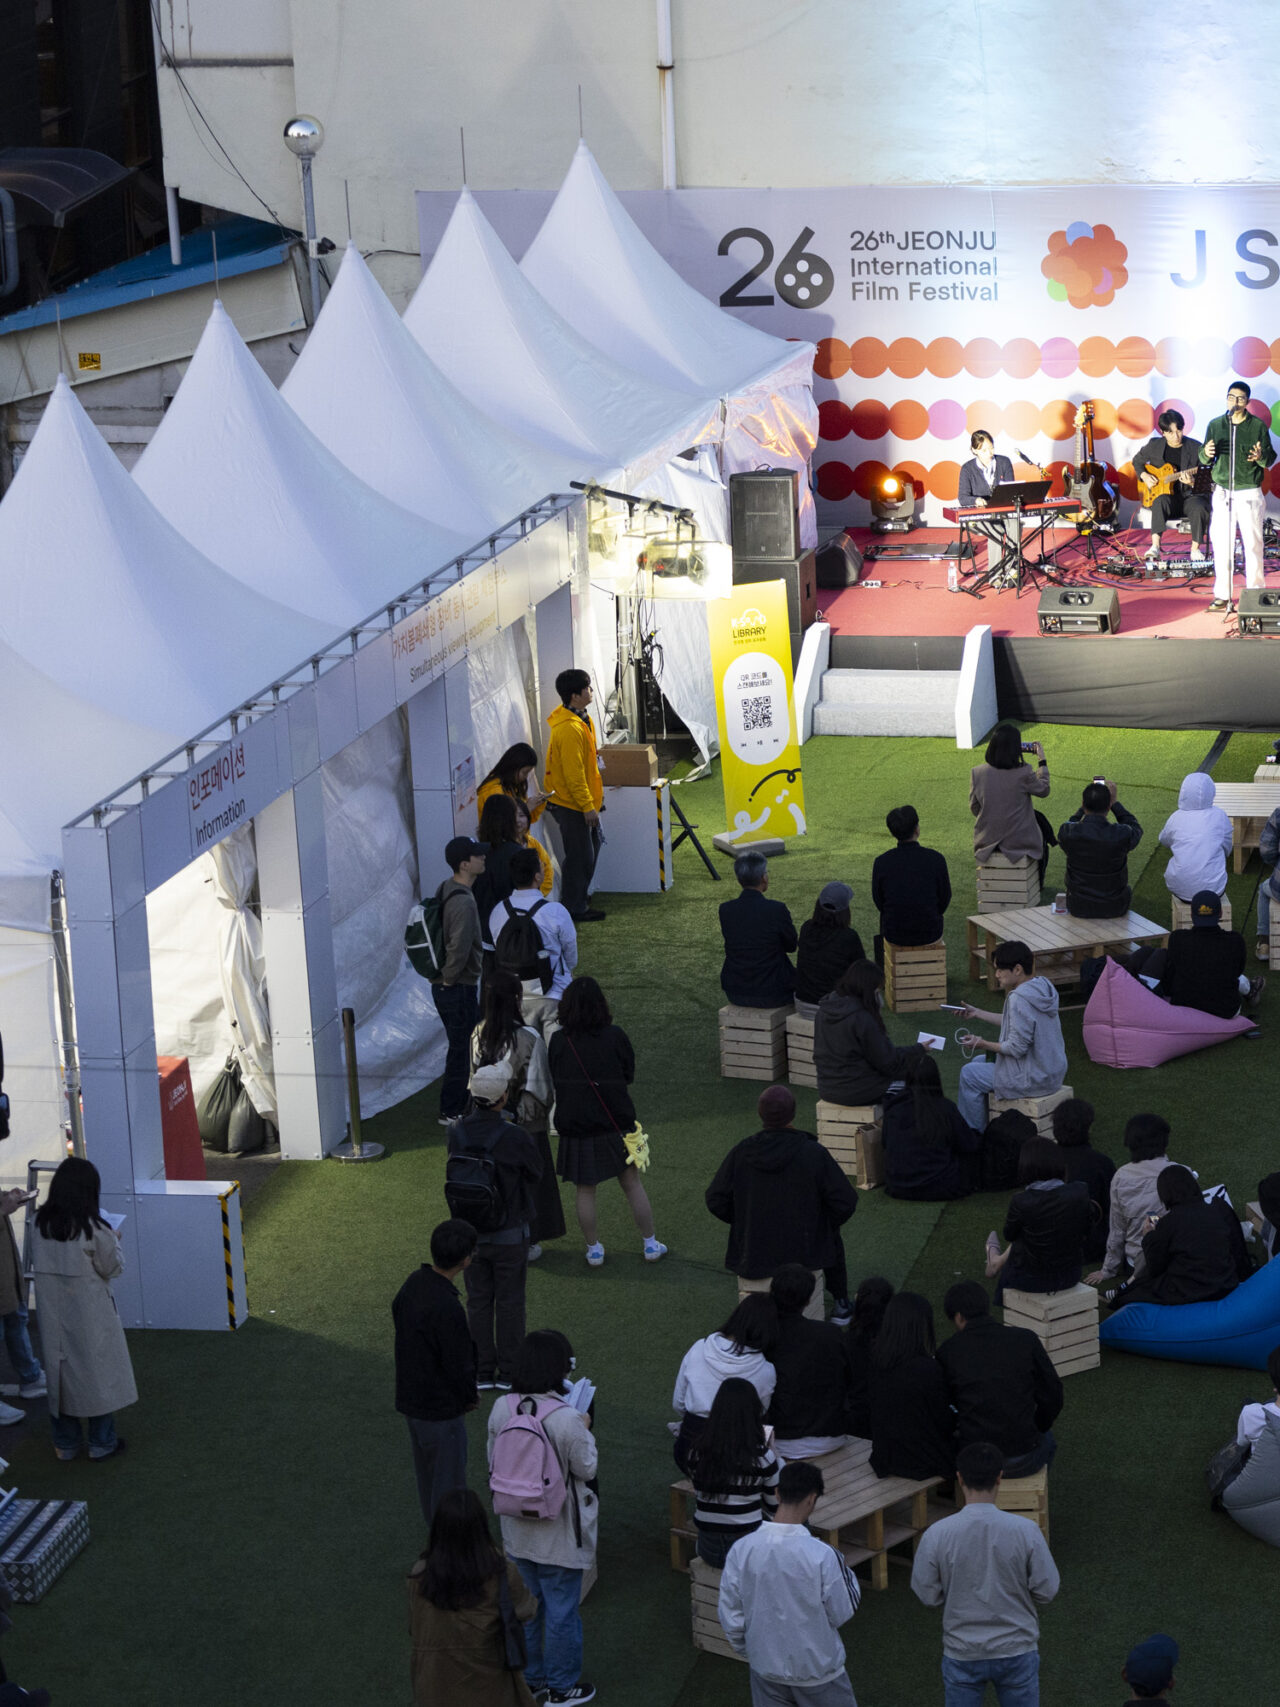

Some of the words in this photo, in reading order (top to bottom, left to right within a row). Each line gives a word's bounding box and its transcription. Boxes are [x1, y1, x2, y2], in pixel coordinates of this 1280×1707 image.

[896, 230, 996, 251] JEONJU
[717, 226, 835, 309] 26
[850, 257, 998, 278] International
[1169, 229, 1207, 289] J
[851, 282, 899, 301] Film
[908, 281, 998, 301] Festival
[732, 627, 767, 638] LIBRARY
[190, 743, 246, 811] 인포메이션
[196, 798, 246, 847] Information
